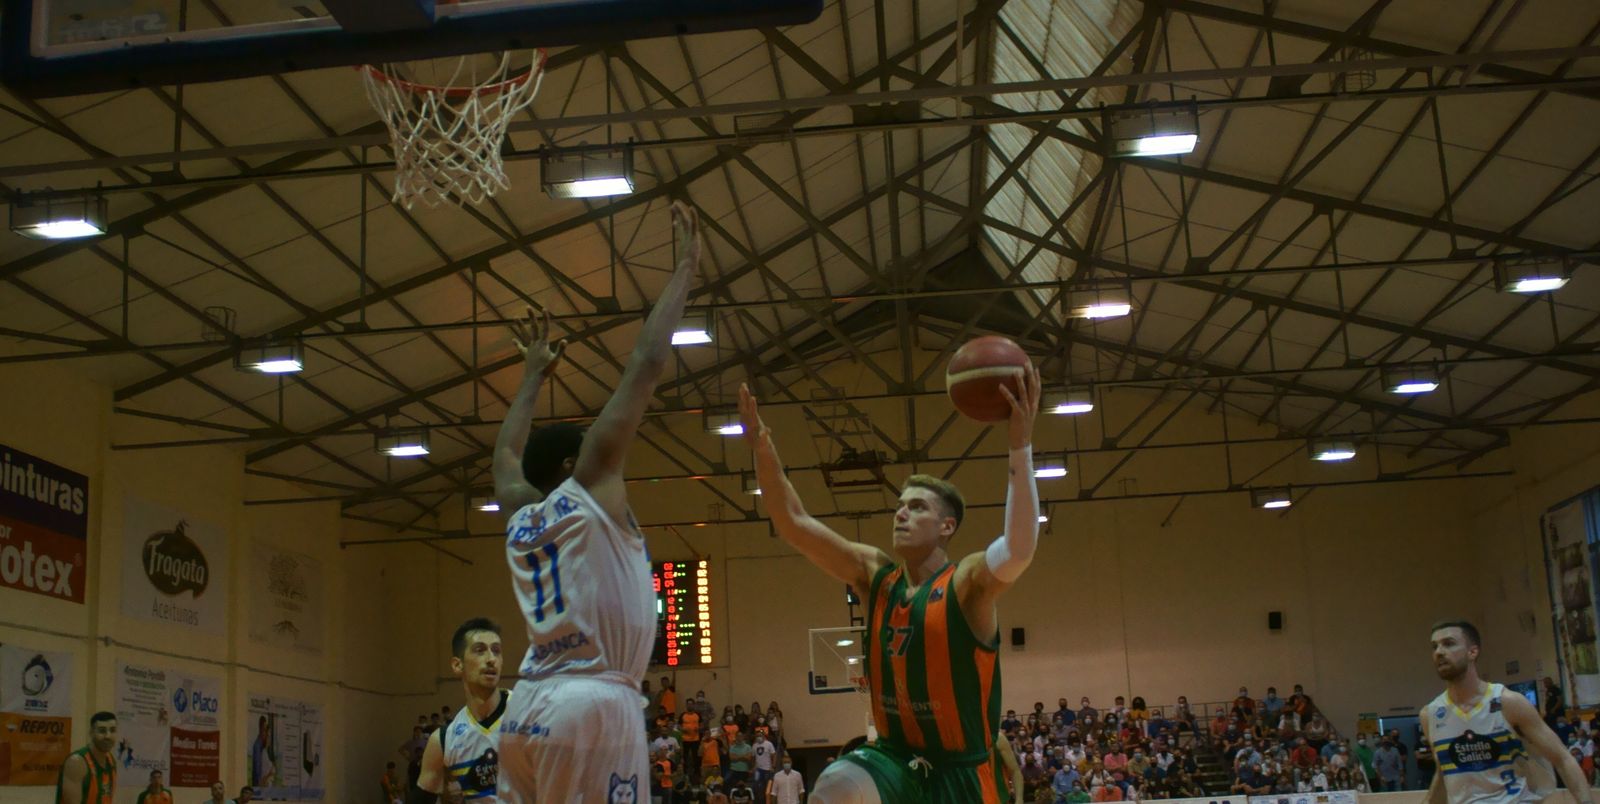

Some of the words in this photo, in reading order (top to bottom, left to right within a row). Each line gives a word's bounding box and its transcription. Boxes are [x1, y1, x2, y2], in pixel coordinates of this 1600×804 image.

[0, 453, 84, 515] inturas
[0, 541, 73, 597] otex
[147, 536, 205, 586] Fragata
[526, 543, 565, 623] 11
[152, 597, 199, 626] Aceitunas
[885, 625, 914, 657] 27
[192, 691, 218, 713] Placo
[20, 719, 65, 736] REPSOL
[1454, 741, 1492, 753] Estrella
[1458, 752, 1493, 763] Galicia
[1499, 769, 1521, 796] 2
